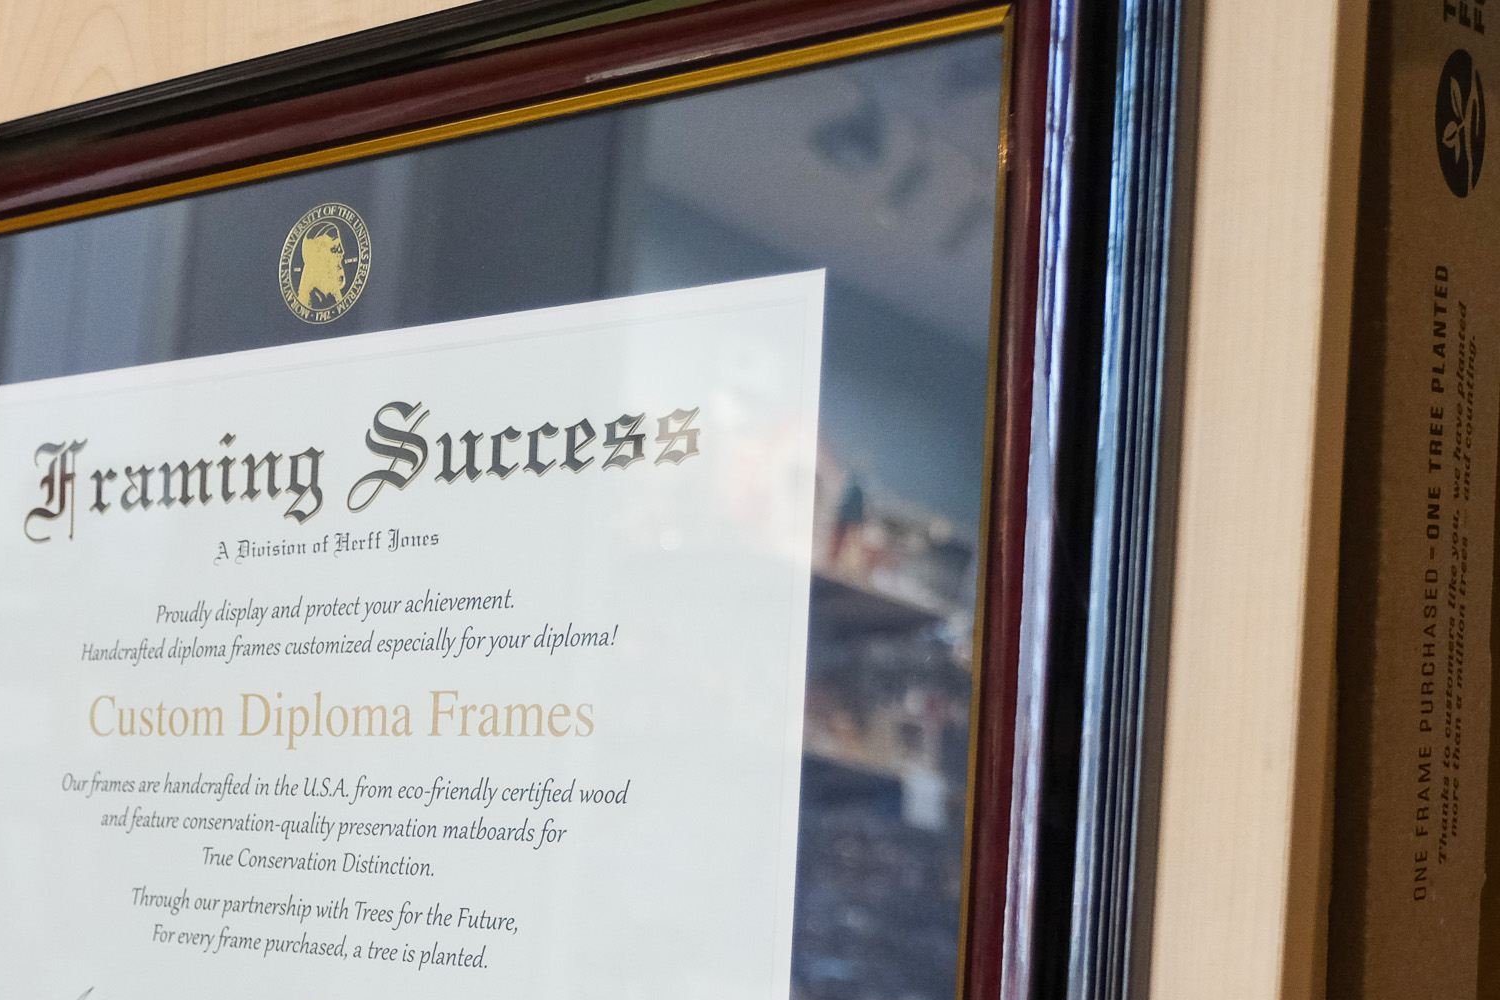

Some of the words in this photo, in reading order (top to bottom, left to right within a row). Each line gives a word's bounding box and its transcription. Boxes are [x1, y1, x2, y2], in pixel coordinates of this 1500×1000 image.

[323, 205, 337, 216] OF
[338, 206, 356, 223] THE
[281, 207, 322, 266] UNIVERSITY
[353, 219, 369, 261] UNITAS
[281, 269, 311, 320] MORAVIAN
[336, 263, 368, 315] FRATRUM
[1431, 265, 1449, 394] PLANTED
[1455, 301, 1467, 400] planted
[1465, 335, 1477, 449] counting.
[1429, 406, 1444, 474] TREE
[1453, 402, 1464, 461] have
[23, 432, 325, 544] Framing
[347, 401, 700, 513] Success
[1453, 467, 1462, 500] we
[1463, 454, 1472, 501] and
[1426, 486, 1441, 540] ONE
[213, 541, 229, 566] A
[234, 538, 306, 565] Division
[312, 535, 329, 554] of
[333, 529, 382, 558] Herff
[387, 528, 440, 552] Jones
[1459, 537, 1469, 596] trees
[155, 599, 213, 629] Proudly
[215, 598, 269, 628] display
[271, 595, 303, 619] and
[303, 596, 361, 624] protect
[360, 600, 402, 622] your
[404, 588, 515, 614] achievement.
[1448, 565, 1458, 610] like
[81, 638, 164, 666] Handcrafted
[167, 637, 226, 665] diploma
[227, 634, 281, 663] frames
[284, 630, 375, 657] customized
[376, 627, 457, 659] especially
[452, 625, 487, 658] for
[485, 633, 531, 657] your
[533, 622, 619, 656] diploma!
[1419, 569, 1439, 732] PURCHASED
[1455, 605, 1466, 689] million
[1445, 617, 1456, 738] customers
[1456, 695, 1463, 710] a
[89, 695, 225, 737] Custom
[238, 690, 413, 750] Diploma
[427, 690, 595, 738] Frames
[1452, 717, 1462, 770] than
[1443, 745, 1451, 769] to
[61, 772, 88, 792] Our
[85, 770, 136, 798] frames
[138, 780, 160, 794] are
[163, 772, 253, 801] handcrafted
[255, 777, 269, 796] in
[273, 774, 299, 797] the
[303, 776, 350, 798] U.S.A.
[348, 775, 393, 805] from
[398, 776, 498, 808] eco-friendly
[501, 777, 577, 810] certified
[579, 779, 631, 805] wood
[1415, 746, 1432, 837] FRAME
[1451, 777, 1460, 838] more
[100, 806, 130, 827] and
[126, 806, 180, 834] feature
[182, 811, 336, 842] conservation-quality
[337, 818, 437, 842] preservation
[442, 816, 535, 842] matboards
[533, 818, 567, 850] for
[1438, 776, 1450, 865] Thanks
[202, 846, 234, 867] True
[237, 848, 337, 872] Conservation
[342, 852, 435, 877] Distinction.
[1413, 850, 1428, 901] ONE
[132, 885, 190, 916] Through
[193, 898, 221, 911] our
[221, 894, 312, 924] partnership
[315, 897, 349, 920] with
[354, 900, 394, 923] Trees
[391, 900, 423, 931] for
[426, 902, 453, 927] the
[457, 907, 519, 935] Future,
[152, 923, 176, 943] For
[177, 931, 215, 953] every
[212, 925, 262, 954] frame
[263, 931, 348, 959] purchased,
[352, 945, 362, 959] a
[367, 940, 398, 961] tree
[402, 943, 415, 963] is
[418, 941, 488, 972] planted.
